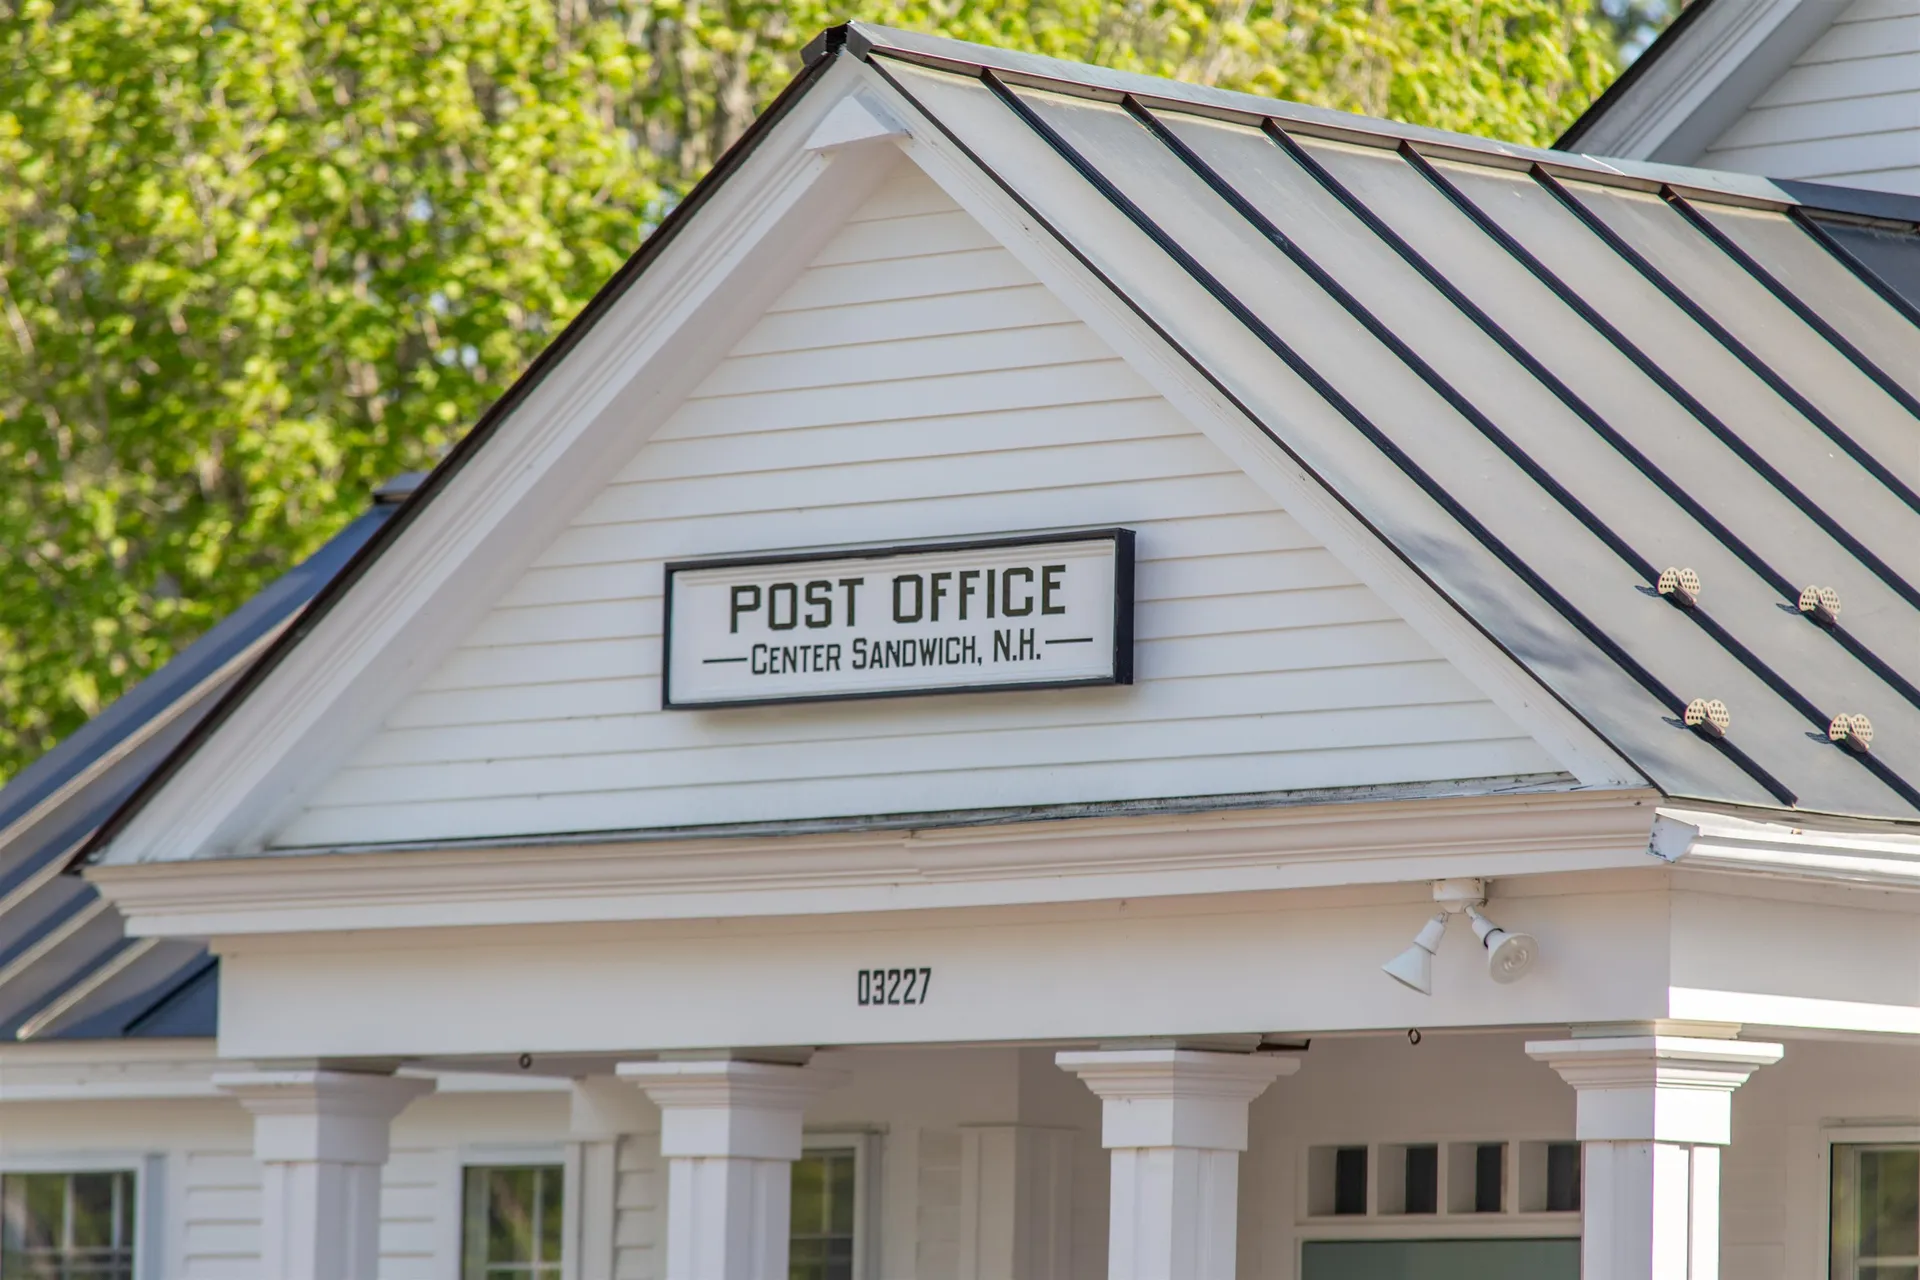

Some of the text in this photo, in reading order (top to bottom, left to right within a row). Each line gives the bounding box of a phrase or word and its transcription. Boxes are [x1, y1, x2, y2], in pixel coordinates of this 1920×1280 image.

[730, 564, 1067, 634] POST OFFICE
[751, 628, 1042, 675] CENTER SANDWICH, N.H.
[857, 967, 932, 1006] 03227
